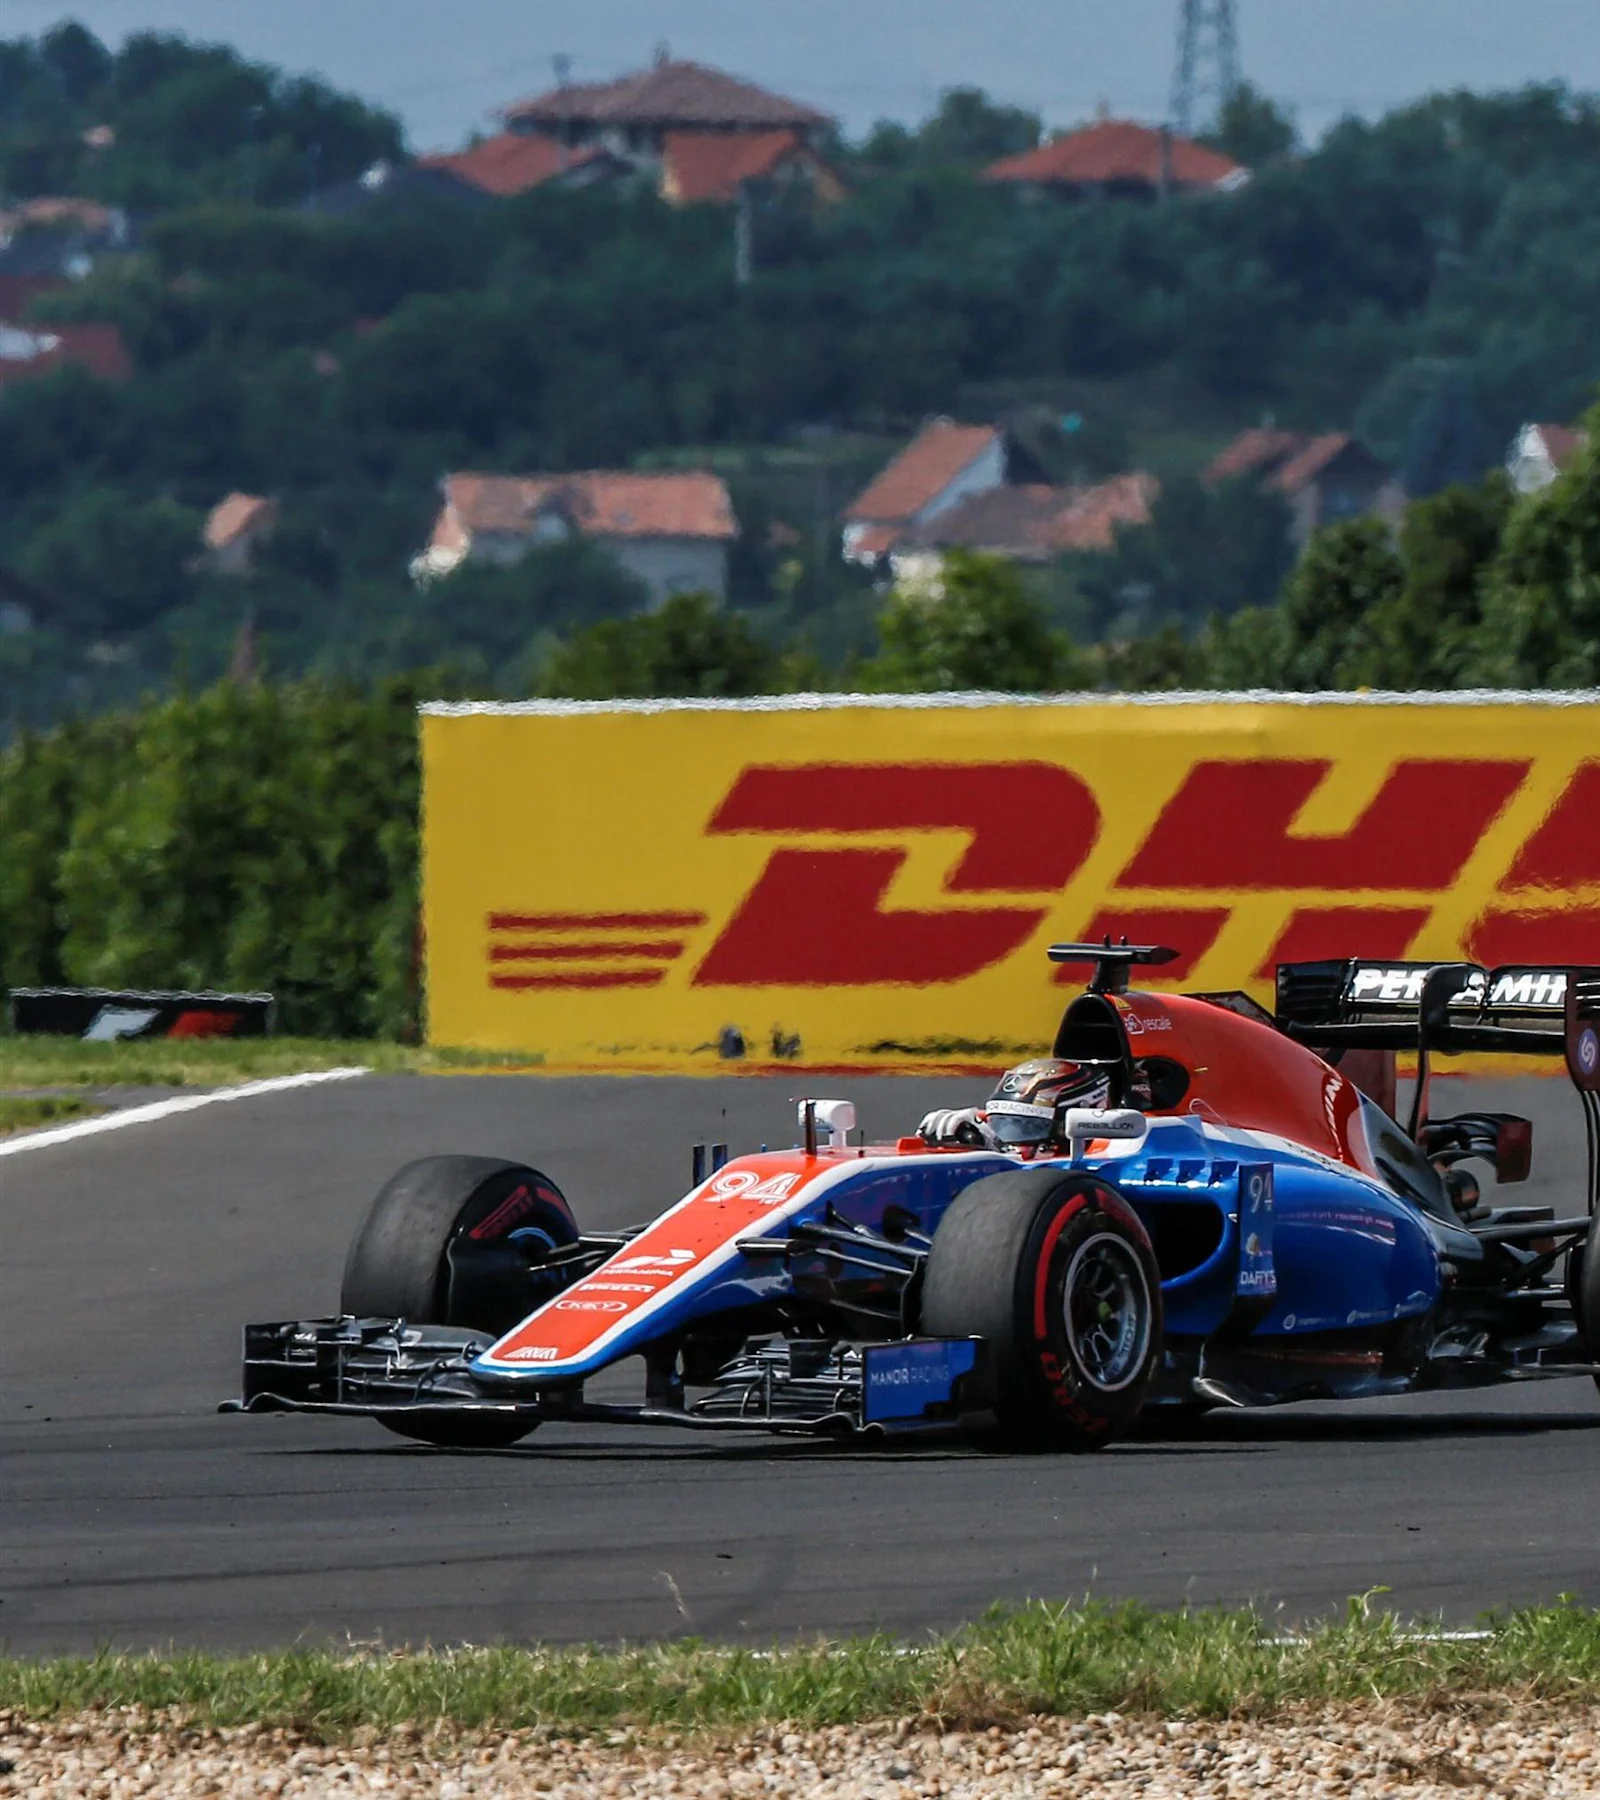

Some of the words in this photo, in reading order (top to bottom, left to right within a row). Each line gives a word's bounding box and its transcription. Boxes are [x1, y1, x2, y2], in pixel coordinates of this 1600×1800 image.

[1077, 1121, 1135, 1130] REBELLION
[704, 1171, 802, 1202] 94
[870, 1366, 909, 1386] MANOR
